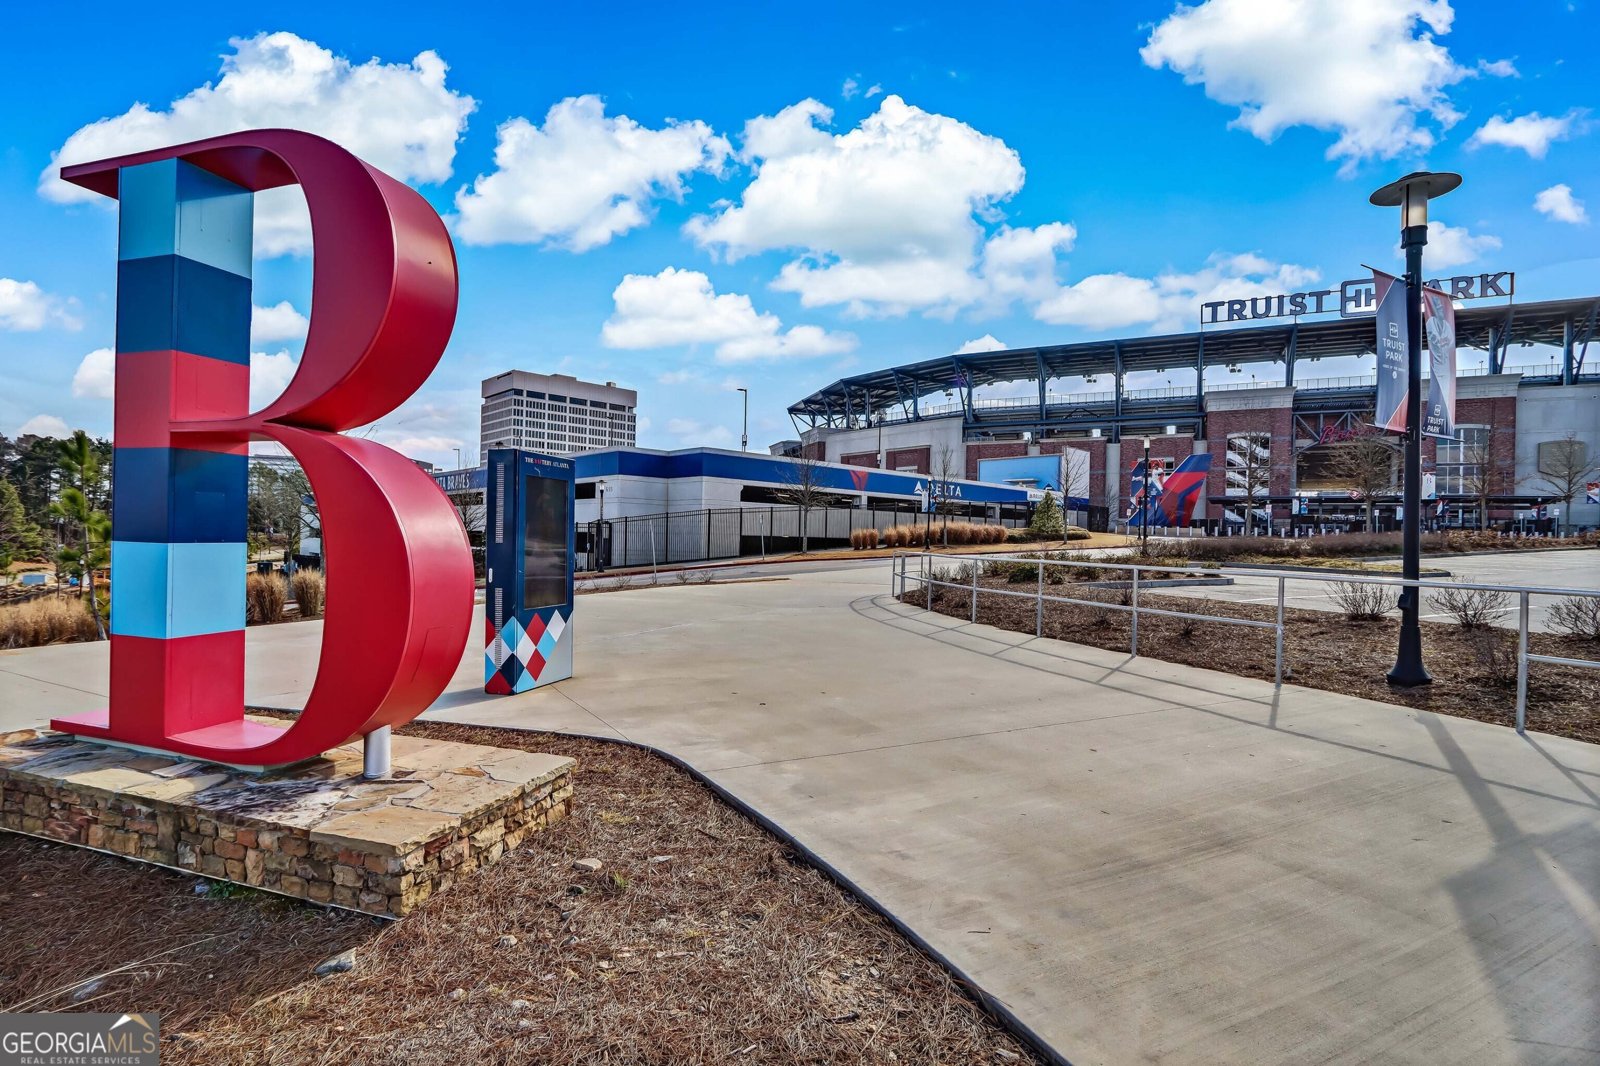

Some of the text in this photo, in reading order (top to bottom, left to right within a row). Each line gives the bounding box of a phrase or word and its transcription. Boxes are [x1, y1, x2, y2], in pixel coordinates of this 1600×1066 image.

[1204, 271, 1507, 323] TRUIST ARK
[1382, 338, 1405, 351] TRUIST
[1385, 350, 1403, 362] PARK
[1427, 416, 1444, 426] TRUIST
[1426, 425, 1441, 434] PARK
[524, 456, 534, 464] THE
[552, 461, 570, 470] ATLANTA
[447, 473, 470, 490] BRAVES
